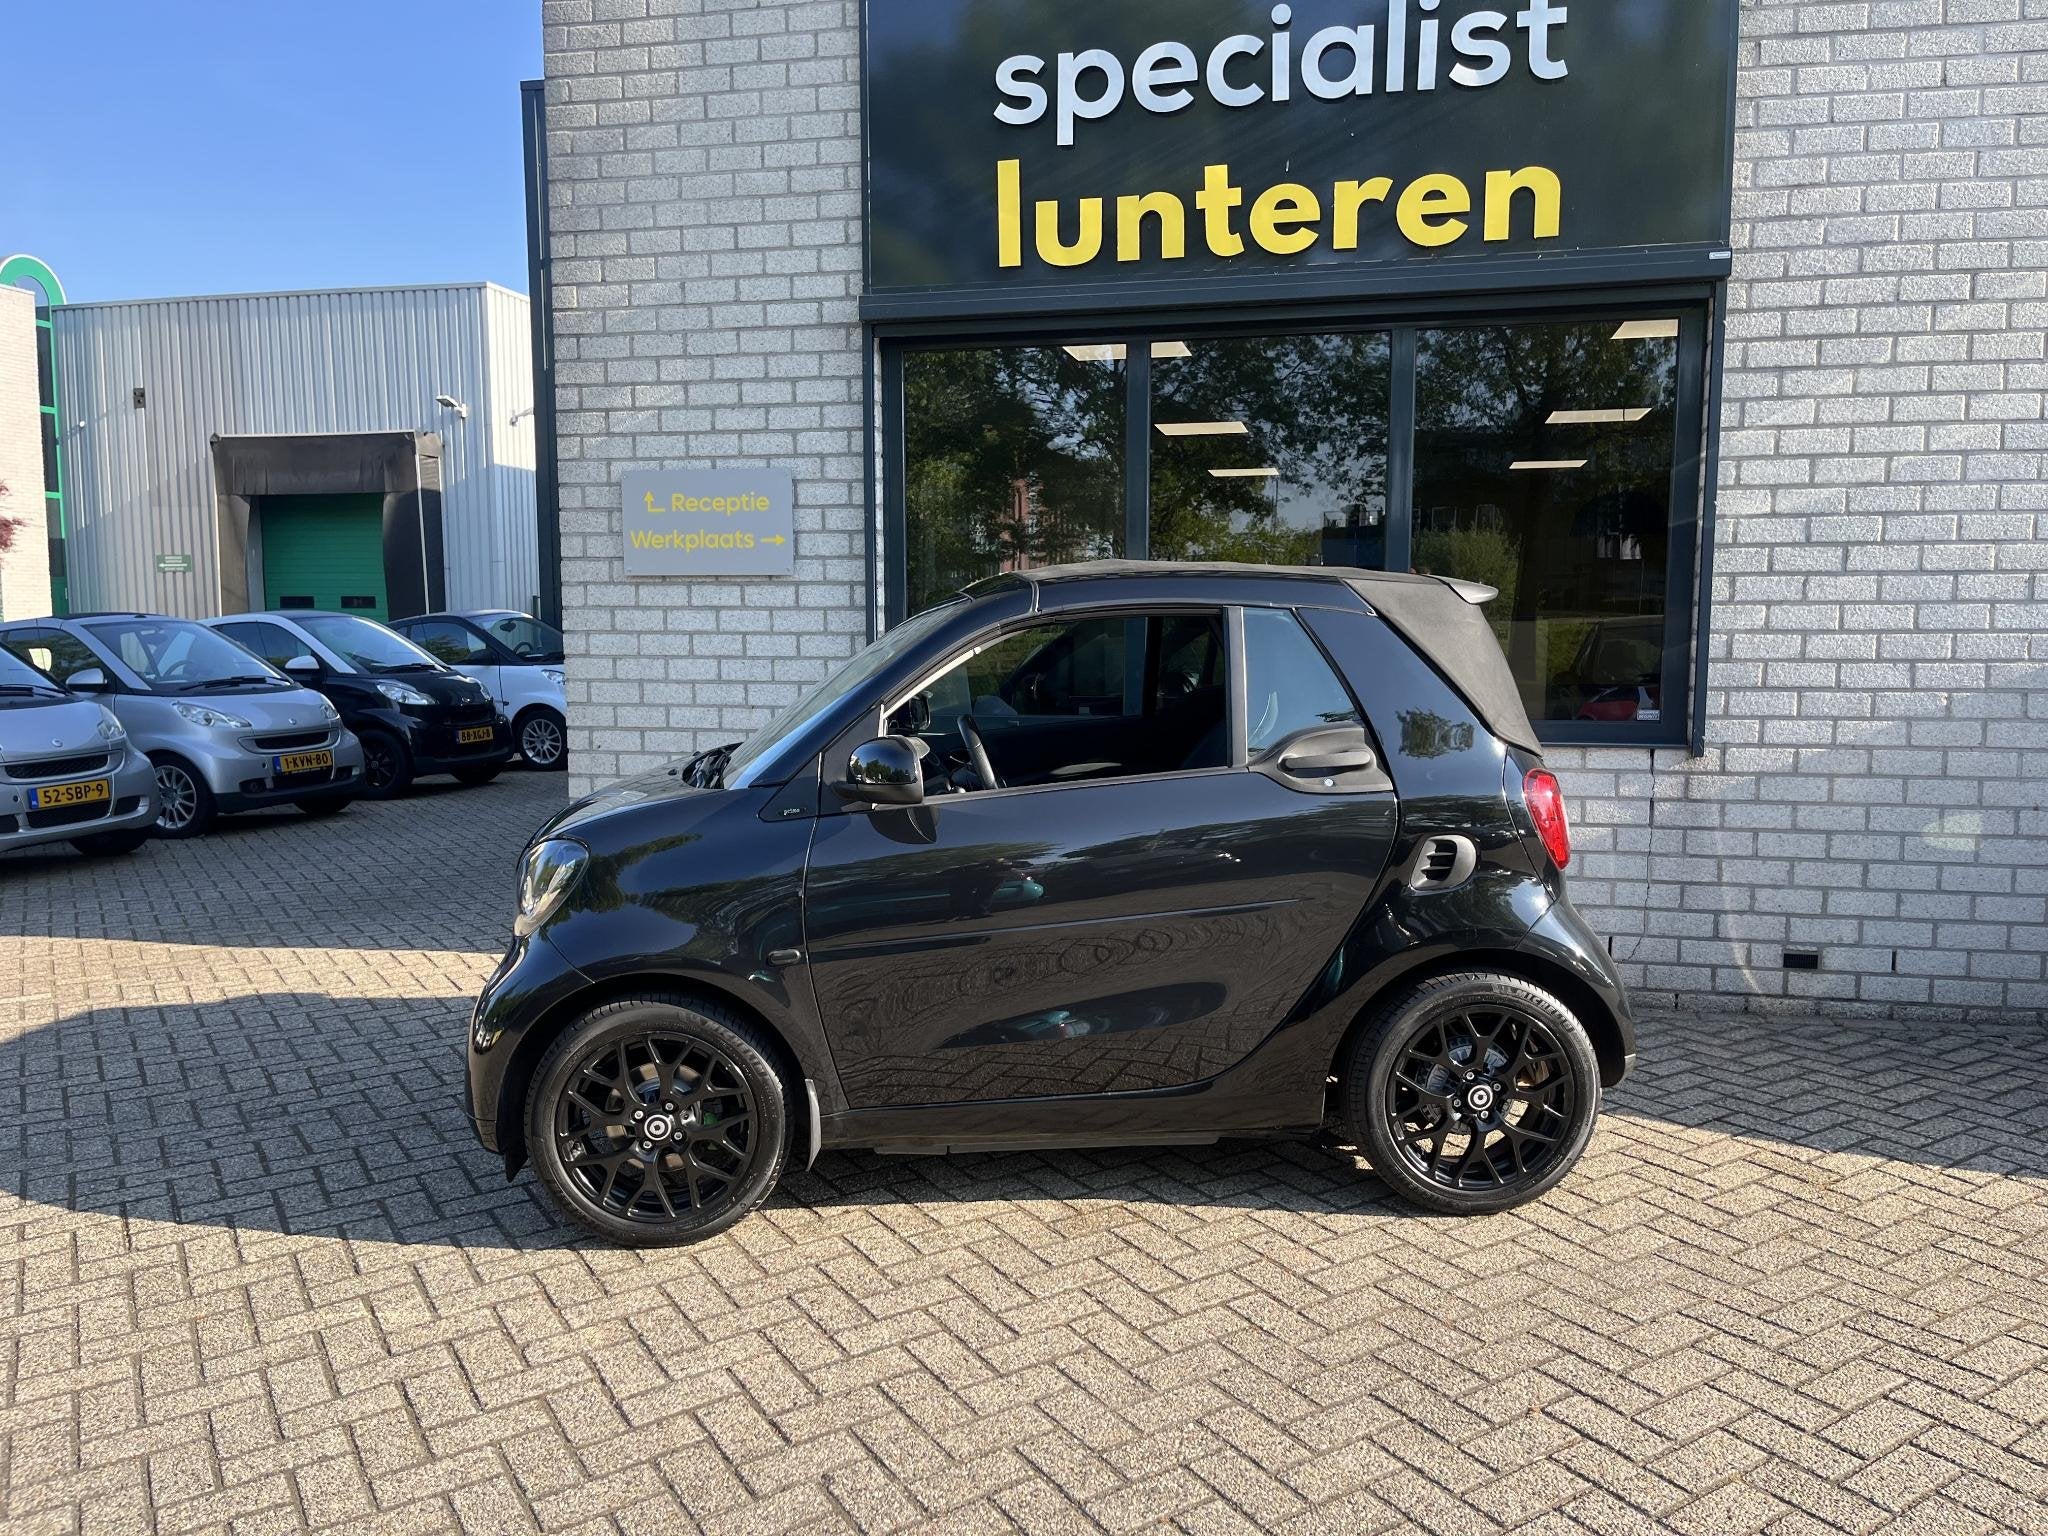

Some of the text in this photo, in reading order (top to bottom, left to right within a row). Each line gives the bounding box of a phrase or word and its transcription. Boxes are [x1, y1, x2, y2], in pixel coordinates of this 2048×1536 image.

[993, 0, 1568, 146] specialist
[997, 160, 1562, 268] lunteren
[671, 491, 770, 516] Receptie
[630, 529, 754, 553] Werkplaats
[284, 753, 329, 769] 1-KVN-80
[43, 783, 104, 804] 52-SBP-9
